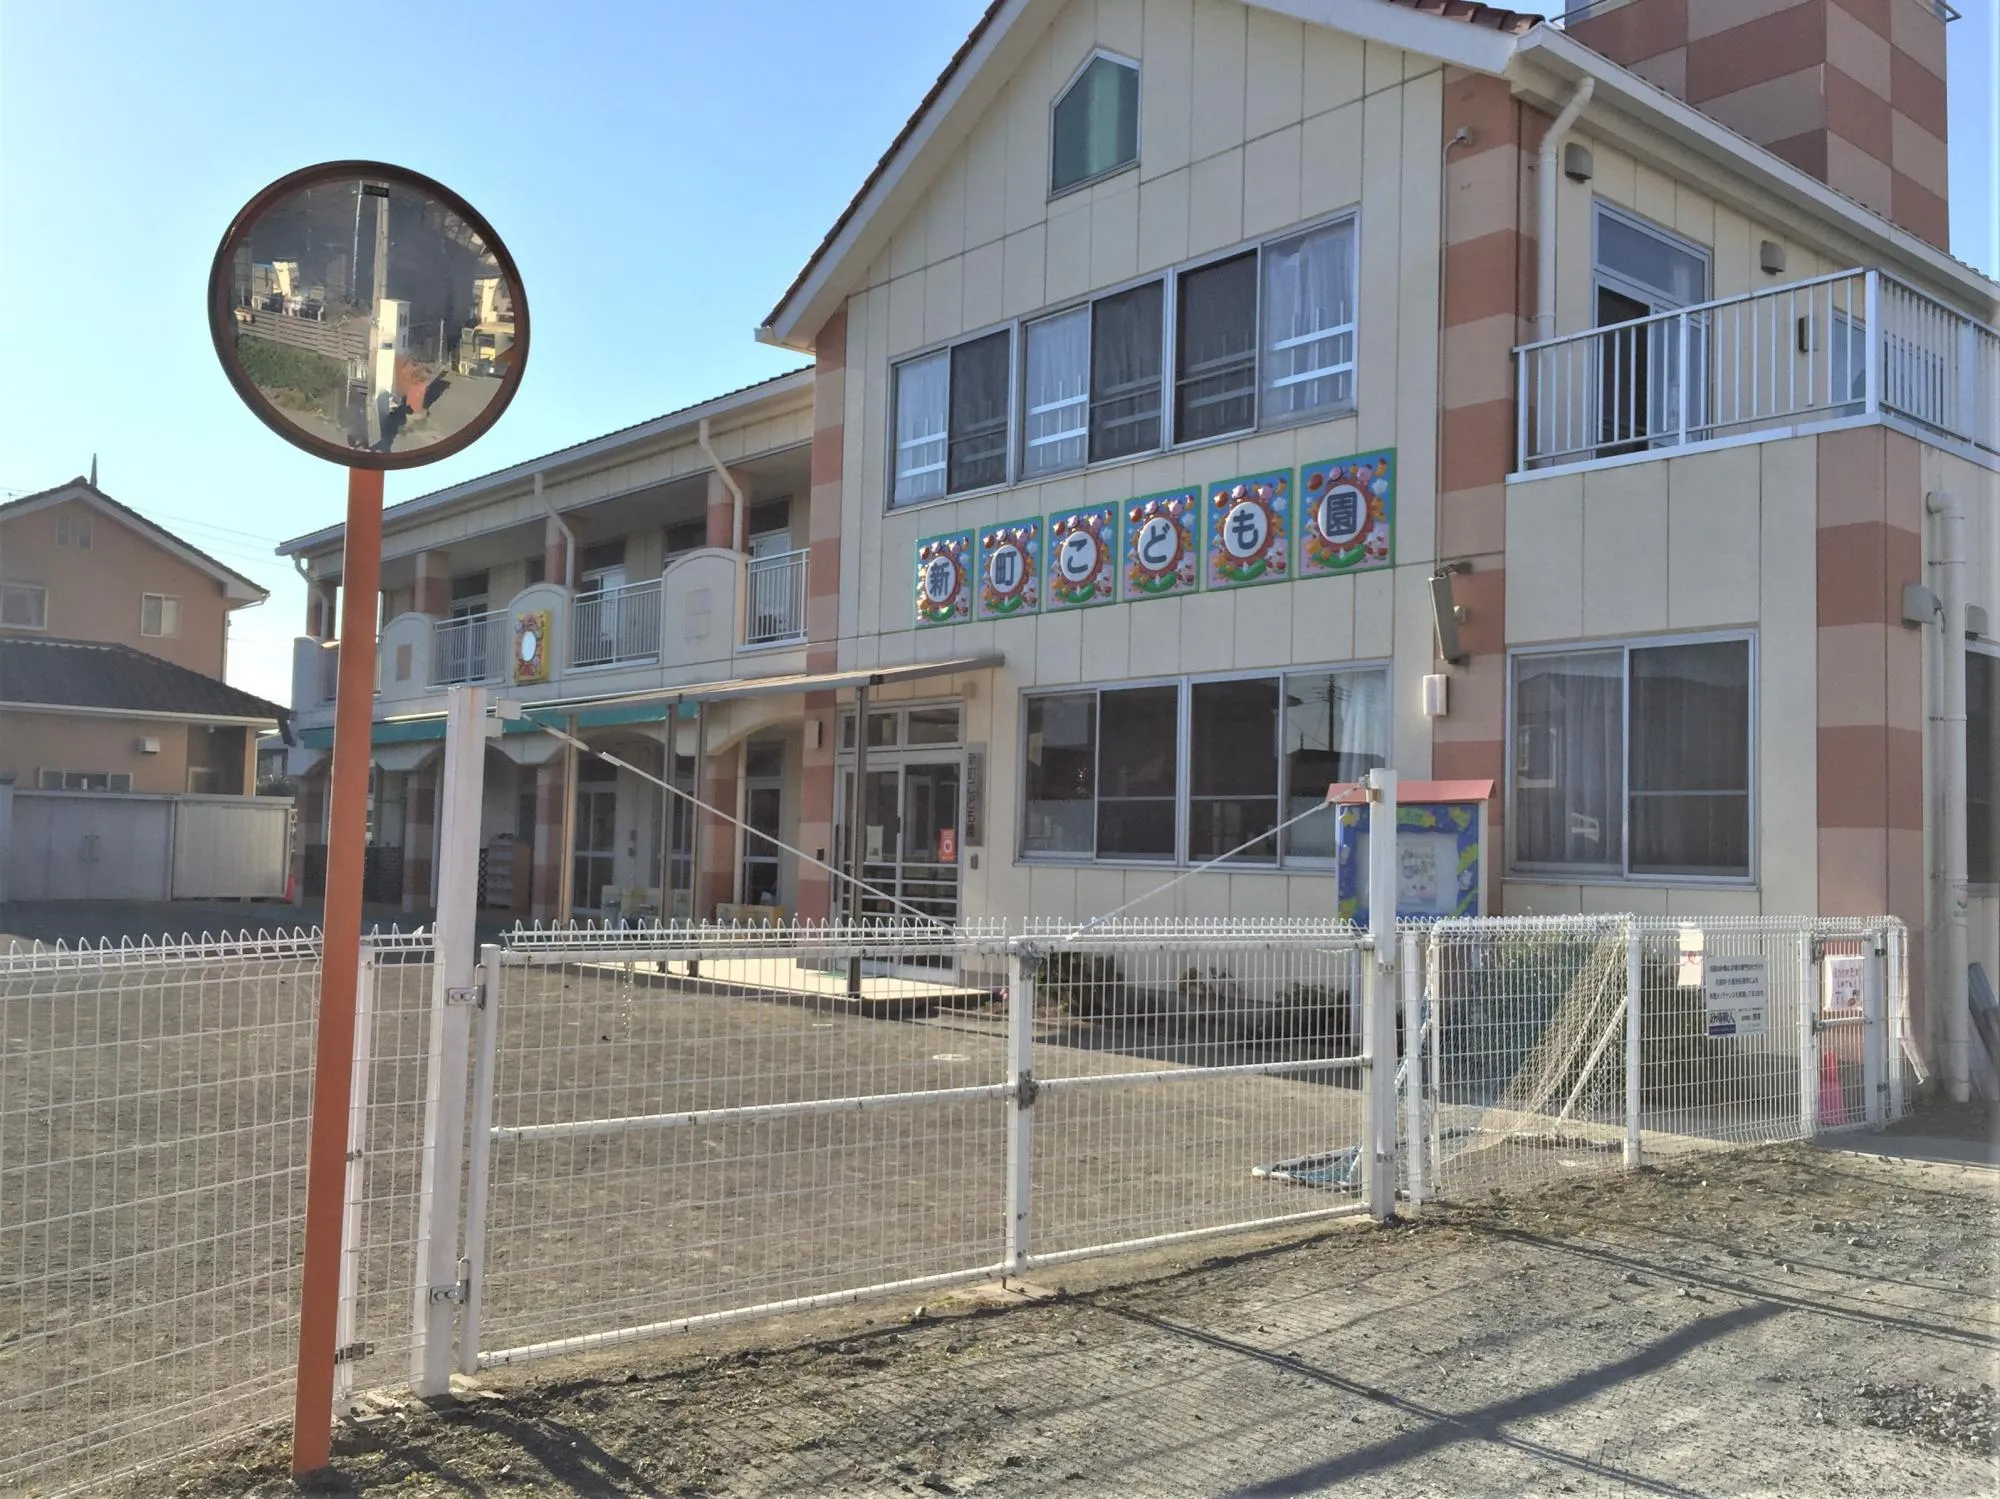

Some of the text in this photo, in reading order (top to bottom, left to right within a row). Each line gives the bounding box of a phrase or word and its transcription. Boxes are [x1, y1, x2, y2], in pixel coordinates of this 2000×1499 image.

[929, 491, 1357, 597] 新町こども園
